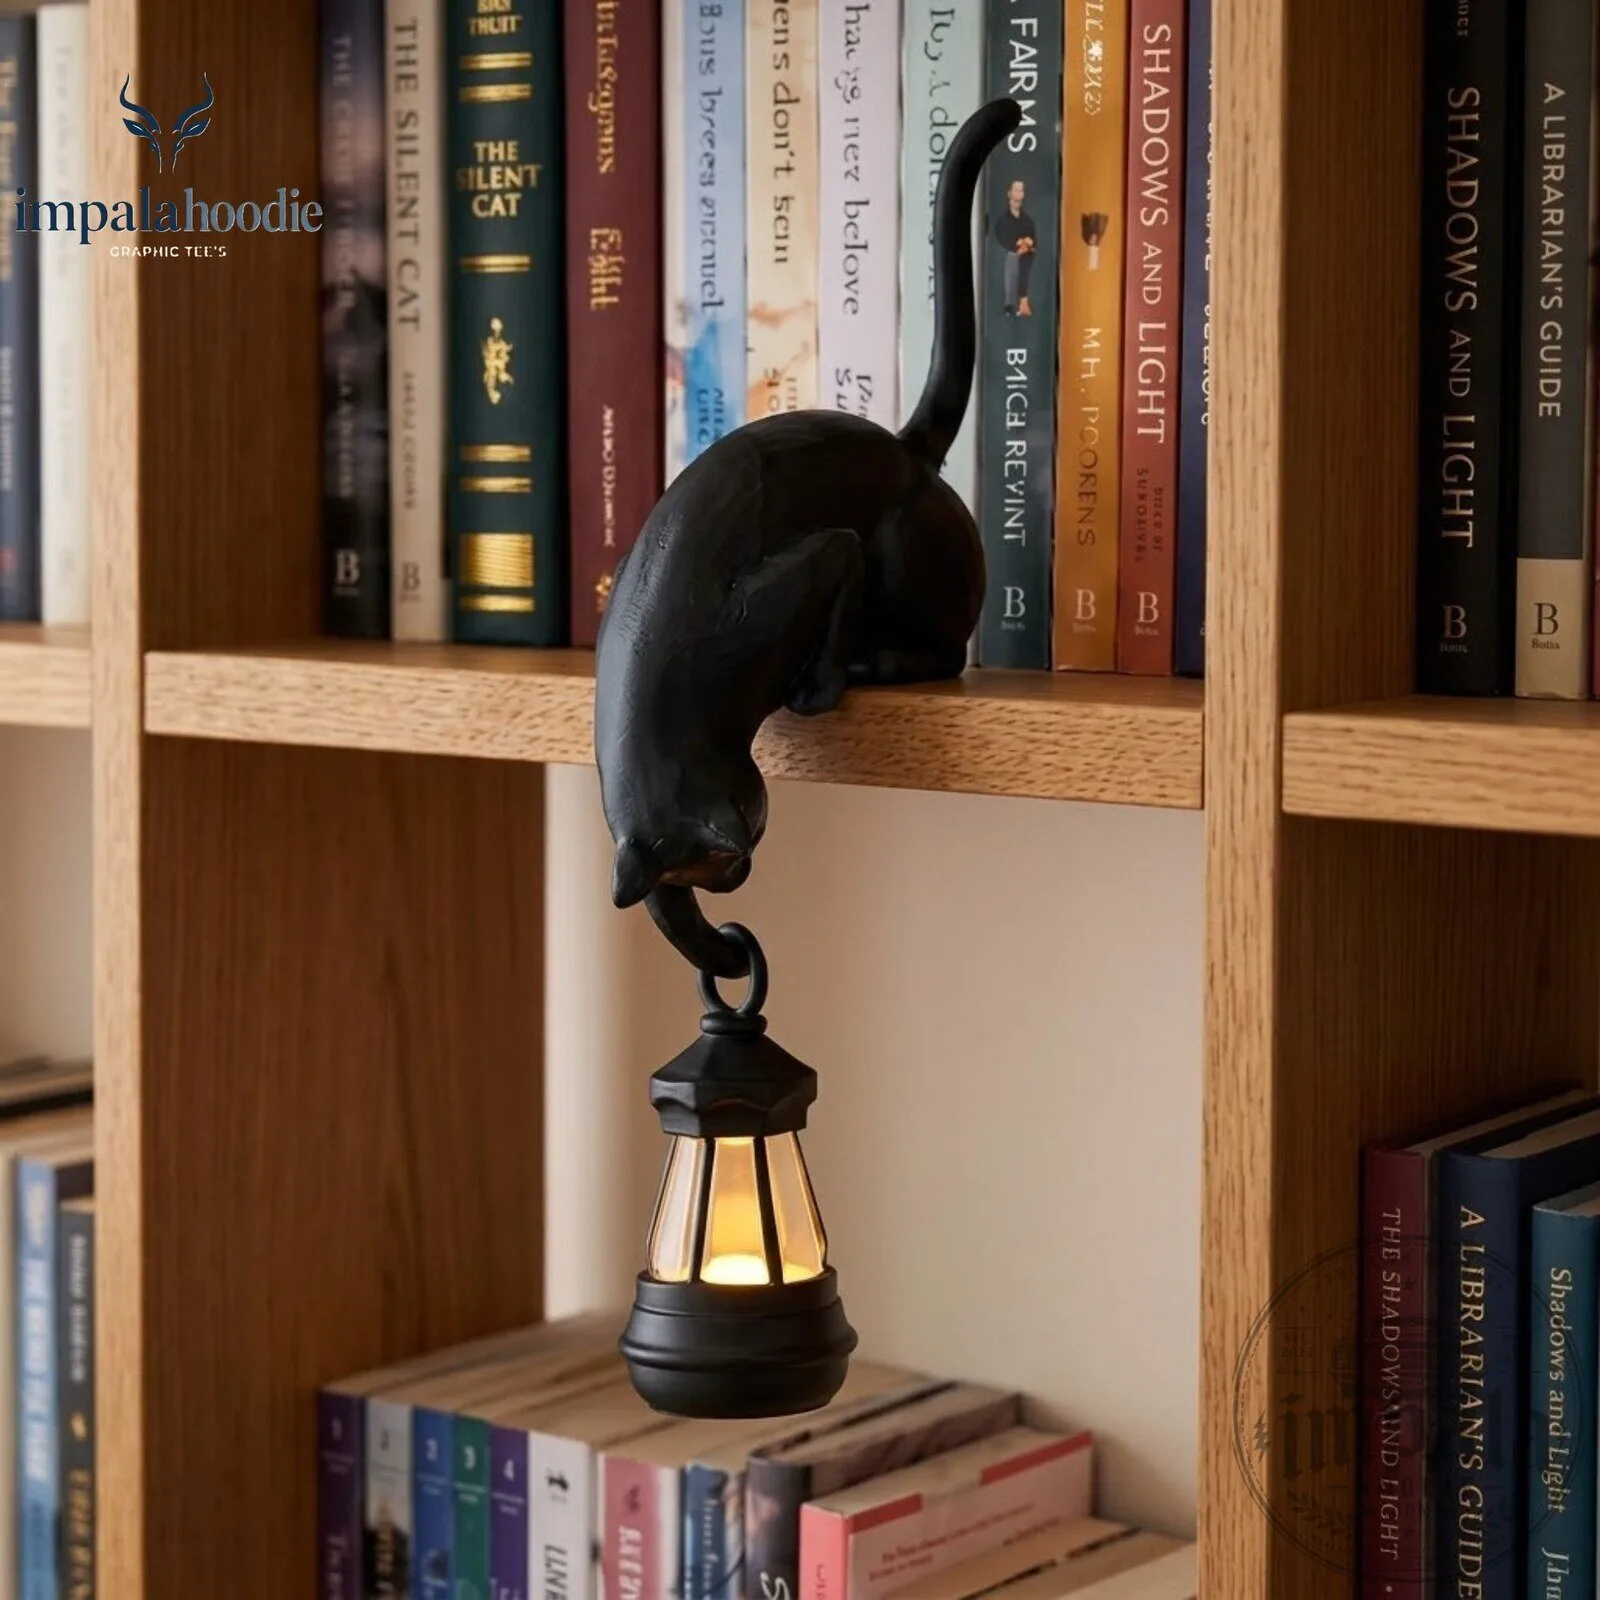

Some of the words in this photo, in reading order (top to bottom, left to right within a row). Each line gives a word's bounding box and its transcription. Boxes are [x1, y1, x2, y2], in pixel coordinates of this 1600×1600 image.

[394, 17, 418, 94] THE
[1140, 24, 1171, 227] SHADOWS
[1543, 82, 1566, 104] A
[474, 141, 519, 162] THE
[773, 81, 800, 178] don't
[395, 110, 420, 246] SILENT
[456, 164, 541, 191] SILENT
[471, 193, 522, 218] CAT
[1445, 86, 1481, 312] SHADOWS
[1540, 115, 1566, 310] LIBRARIAN'S
[398, 258, 420, 330] CAT
[1143, 241, 1162, 305] AND
[1136, 322, 1167, 444] LIGHT
[1449, 329, 1472, 397] AND
[1539, 320, 1563, 417] GUIDE
[1441, 414, 1476, 548] LIGHT
[335, 550, 361, 584] B
[1003, 586, 1026, 618] B
[1074, 588, 1097, 621] B
[1136, 591, 1159, 623] B
[1441, 604, 1467, 639] B
[1534, 602, 1559, 636] B
[1381, 1208, 1401, 1261] THE
[1459, 1205, 1486, 1229] A
[1381, 1270, 1401, 1402] SHADOWS
[1458, 1243, 1486, 1472] LIBRARIAN'S
[1549, 1266, 1573, 1382] Shadows
[1548, 1391, 1571, 1437] and
[1541, 1447, 1571, 1514] Light
[1379, 1476, 1400, 1561] LIGHT
[1457, 1485, 1484, 1600] GUIDE
